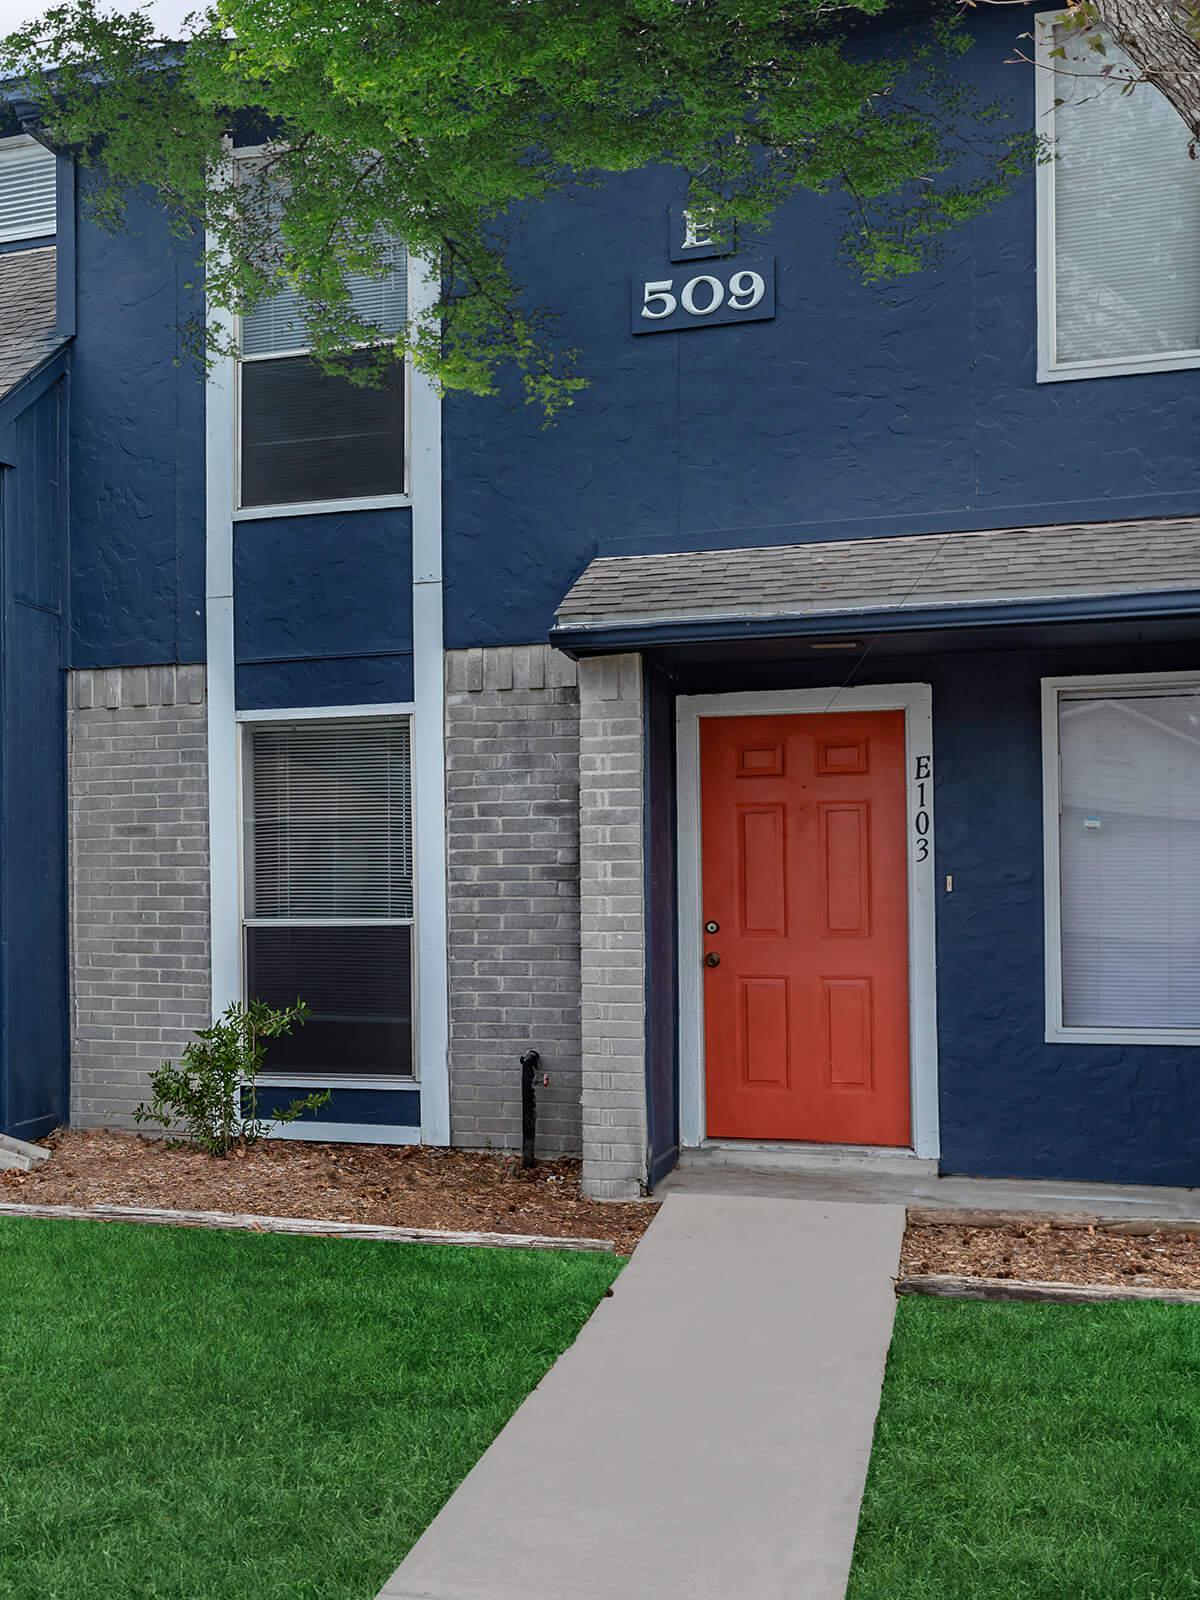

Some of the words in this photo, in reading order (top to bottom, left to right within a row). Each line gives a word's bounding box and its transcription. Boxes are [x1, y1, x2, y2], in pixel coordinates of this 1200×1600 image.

[681, 207, 720, 249] E
[641, 271, 765, 319] 509
[914, 755, 931, 862] E103
